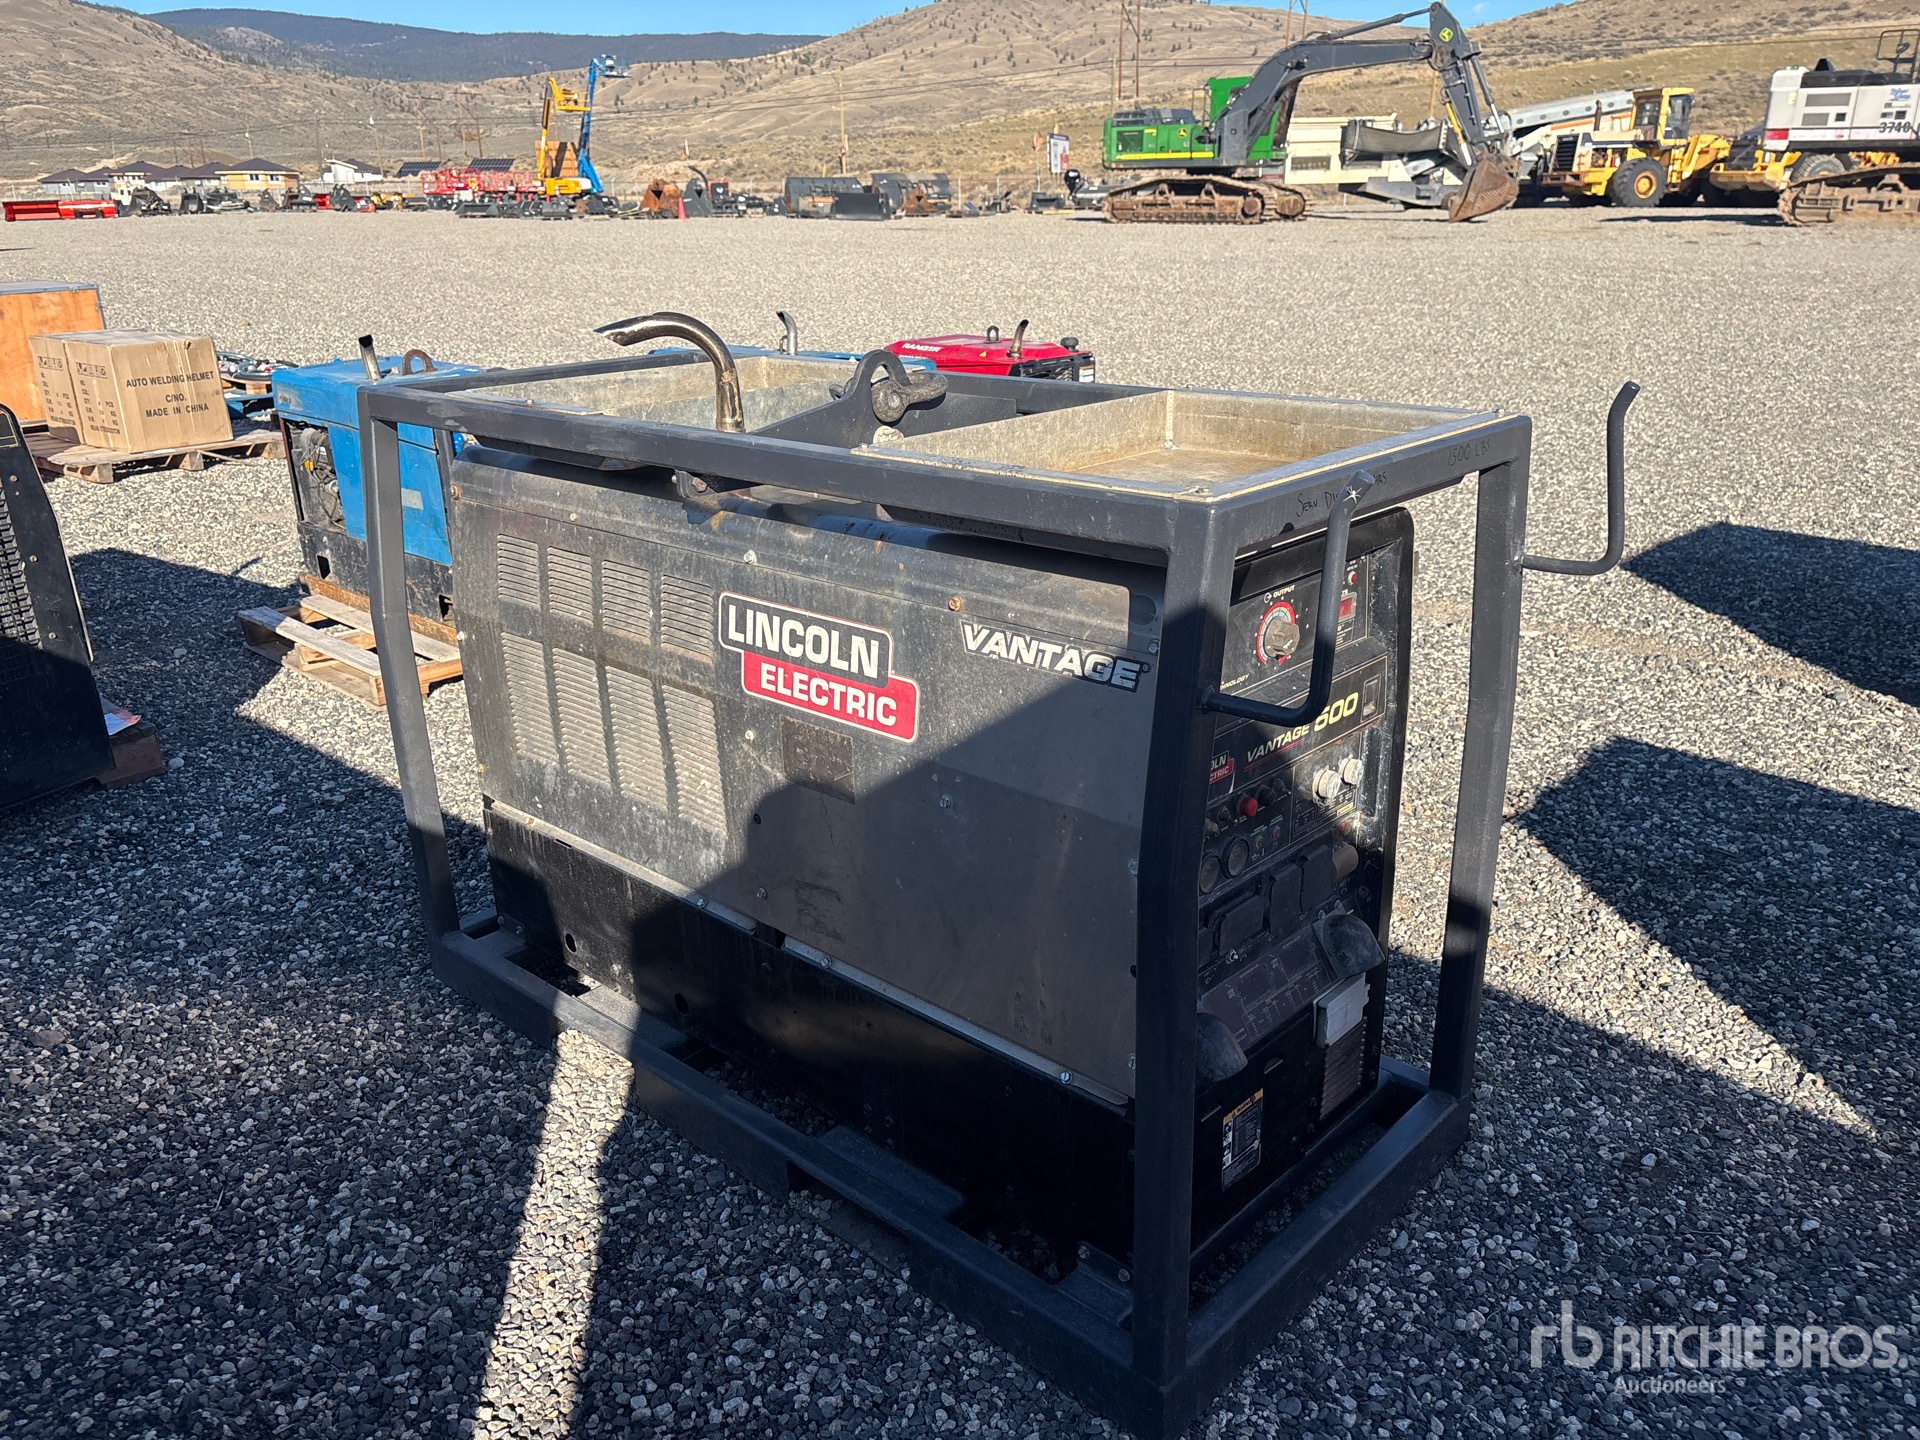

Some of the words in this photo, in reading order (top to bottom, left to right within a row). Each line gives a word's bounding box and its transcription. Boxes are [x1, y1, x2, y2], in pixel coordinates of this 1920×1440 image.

[901, 343, 942, 353] RANGER
[126, 378, 148, 388] AUTO
[149, 374, 185, 386] WELDING
[186, 371, 214, 382] HELMET
[165, 393, 187, 403] C/NO.
[146, 407, 169, 418] MADE
[172, 406, 182, 415] IN
[185, 403, 209, 413] CHINA
[1273, 585, 1296, 599] OUTPUT
[728, 604, 880, 679] LINCOLN
[760, 662, 897, 727] ELECTRIC
[1247, 724, 1310, 763] VANTAGE
